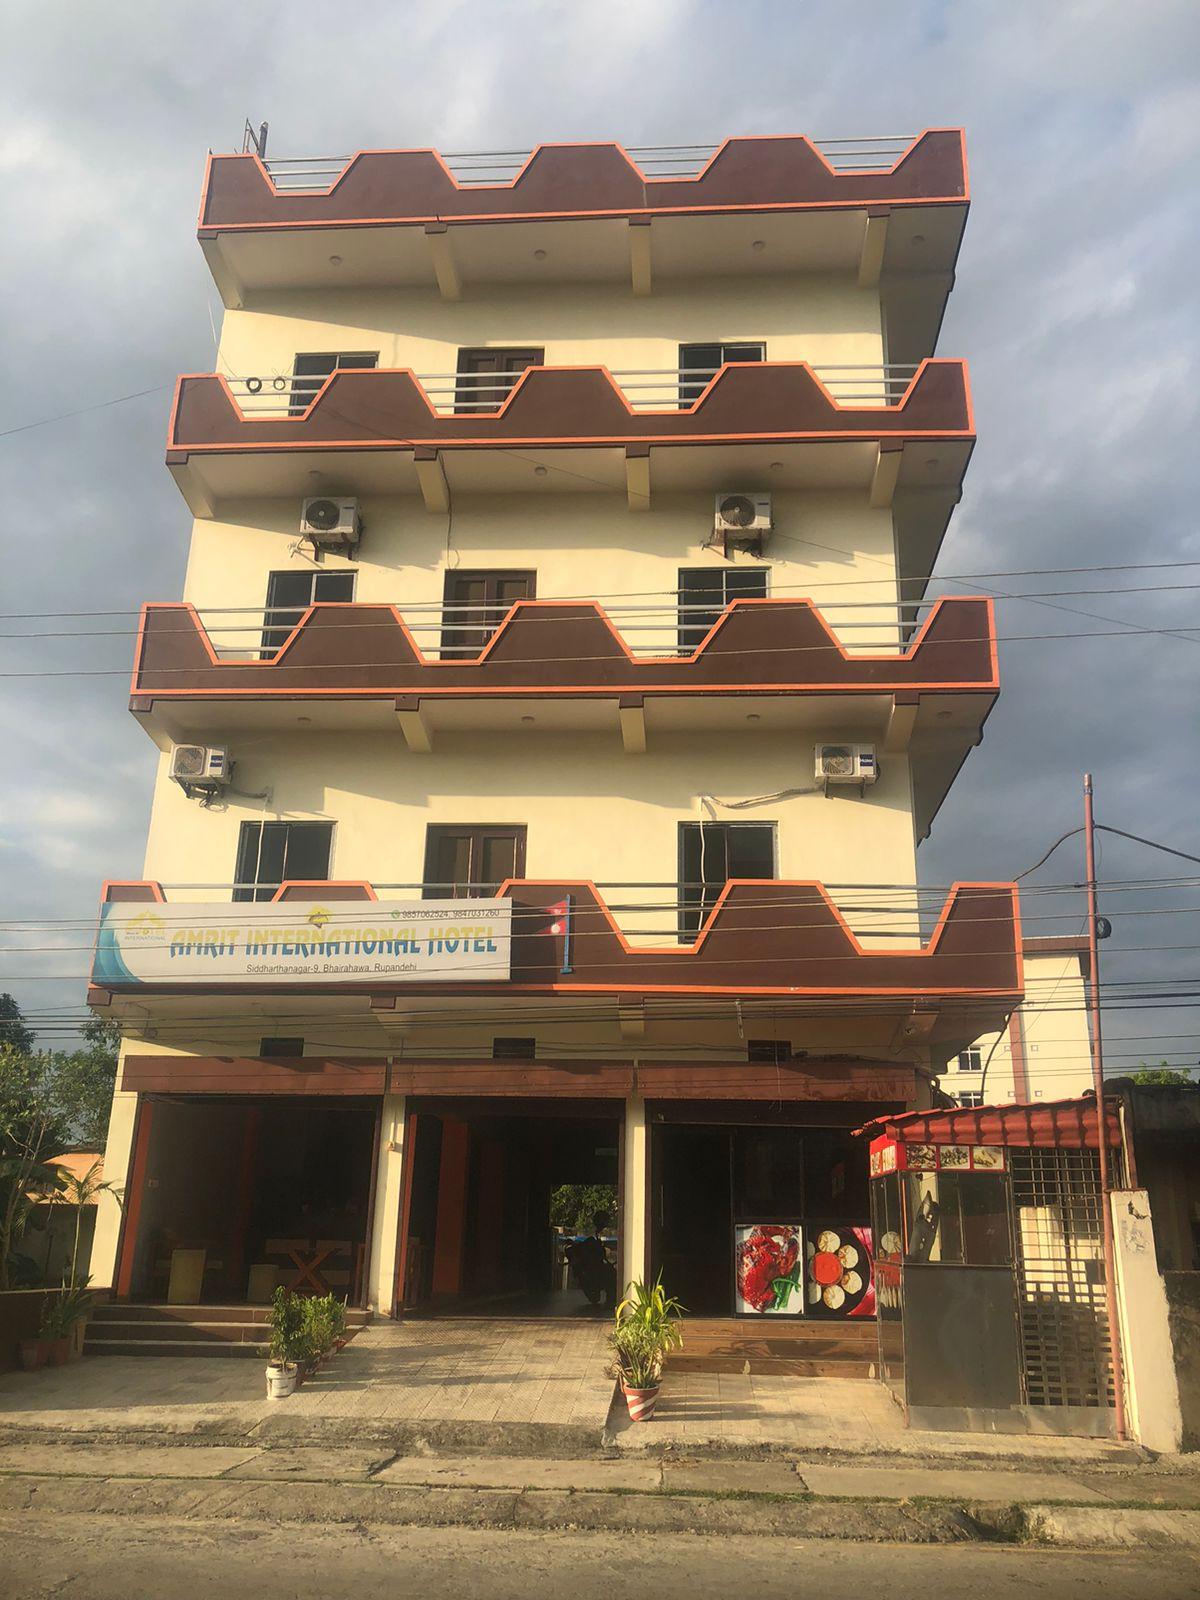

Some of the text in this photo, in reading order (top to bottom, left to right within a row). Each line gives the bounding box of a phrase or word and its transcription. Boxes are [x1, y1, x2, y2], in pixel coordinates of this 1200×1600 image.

[170, 926, 498, 958] AMRIT INTERNATIONAL HOTEL
[374, 962, 417, 972] Rupandehi
